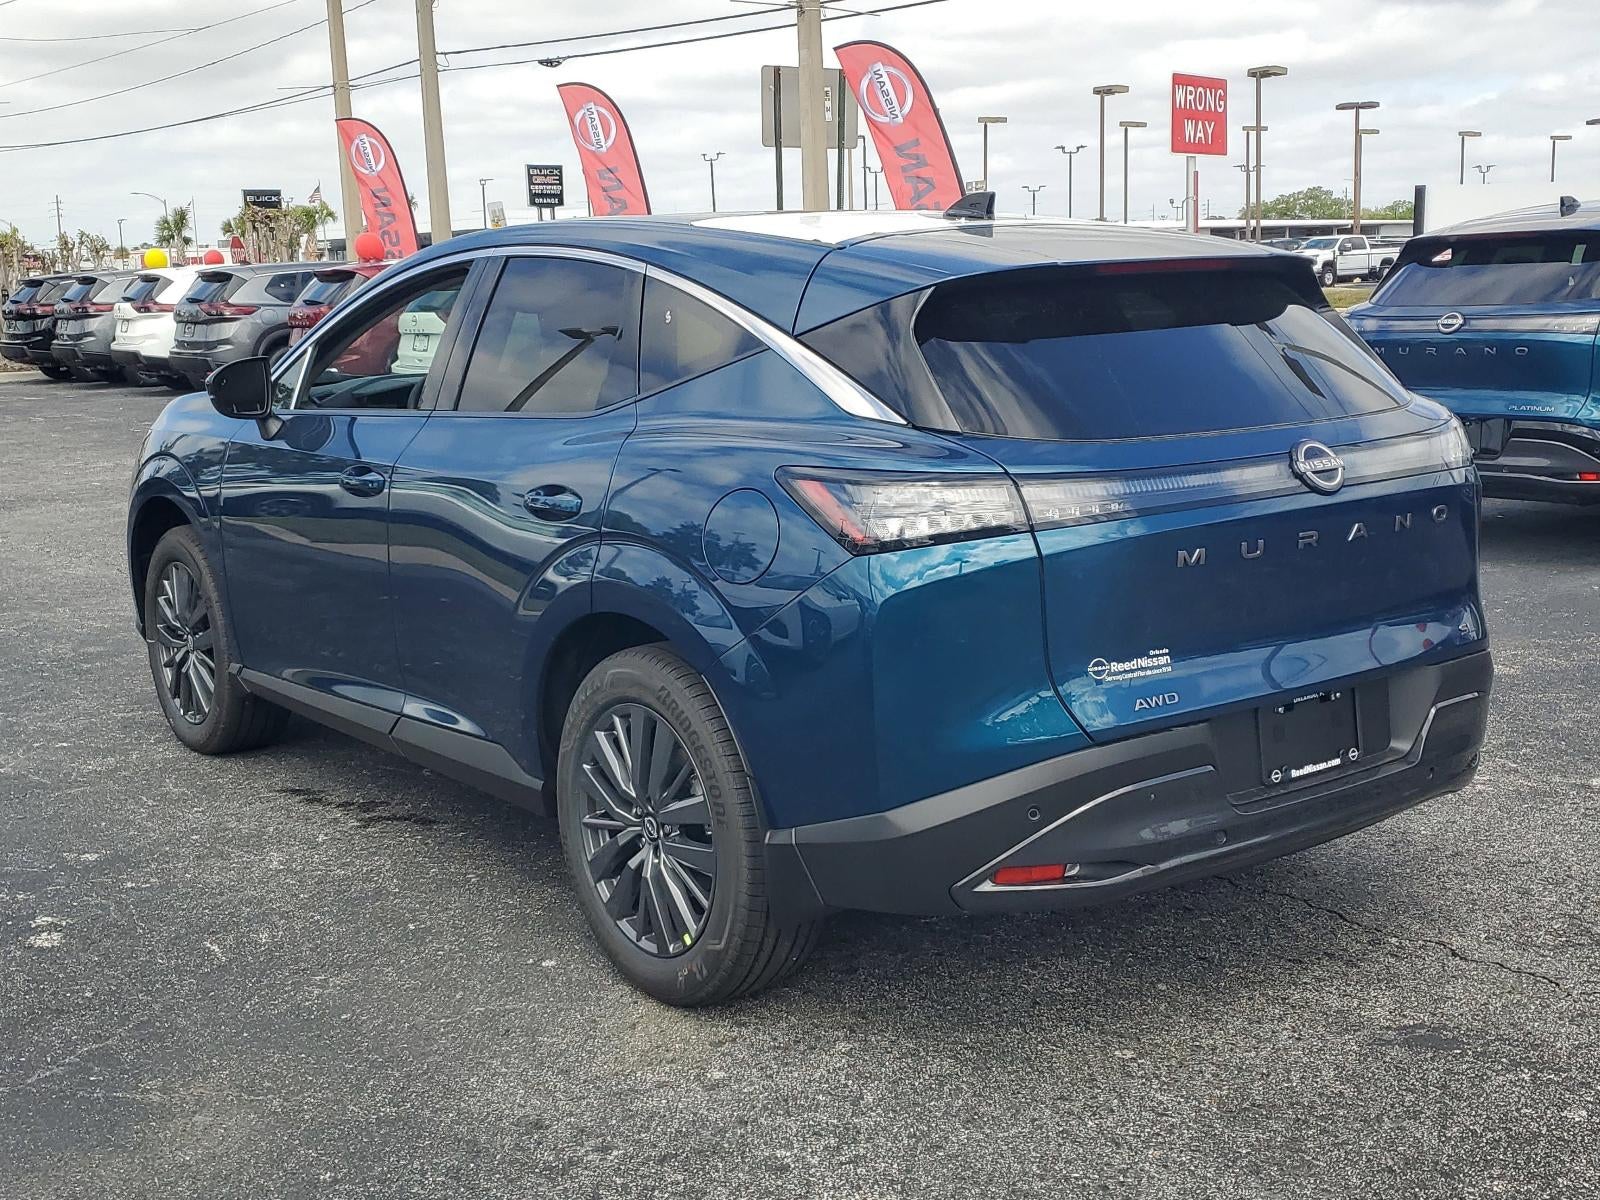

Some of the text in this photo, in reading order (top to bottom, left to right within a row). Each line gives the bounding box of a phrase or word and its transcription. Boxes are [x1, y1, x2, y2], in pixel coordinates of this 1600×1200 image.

[1175, 84, 1225, 113] WRONG
[1184, 118, 1215, 145] WAY
[529, 168, 561, 176] BUICK
[532, 176, 560, 184] GMC
[246, 195, 280, 203] BUICK
[231, 247, 246, 264] STOP
[1373, 346, 1529, 357] MURANO
[1508, 404, 1555, 413] PLATINUM
[1299, 455, 1345, 473] NISSAN
[1176, 503, 1449, 569] MURANO
[1134, 692, 1179, 712] AWD
